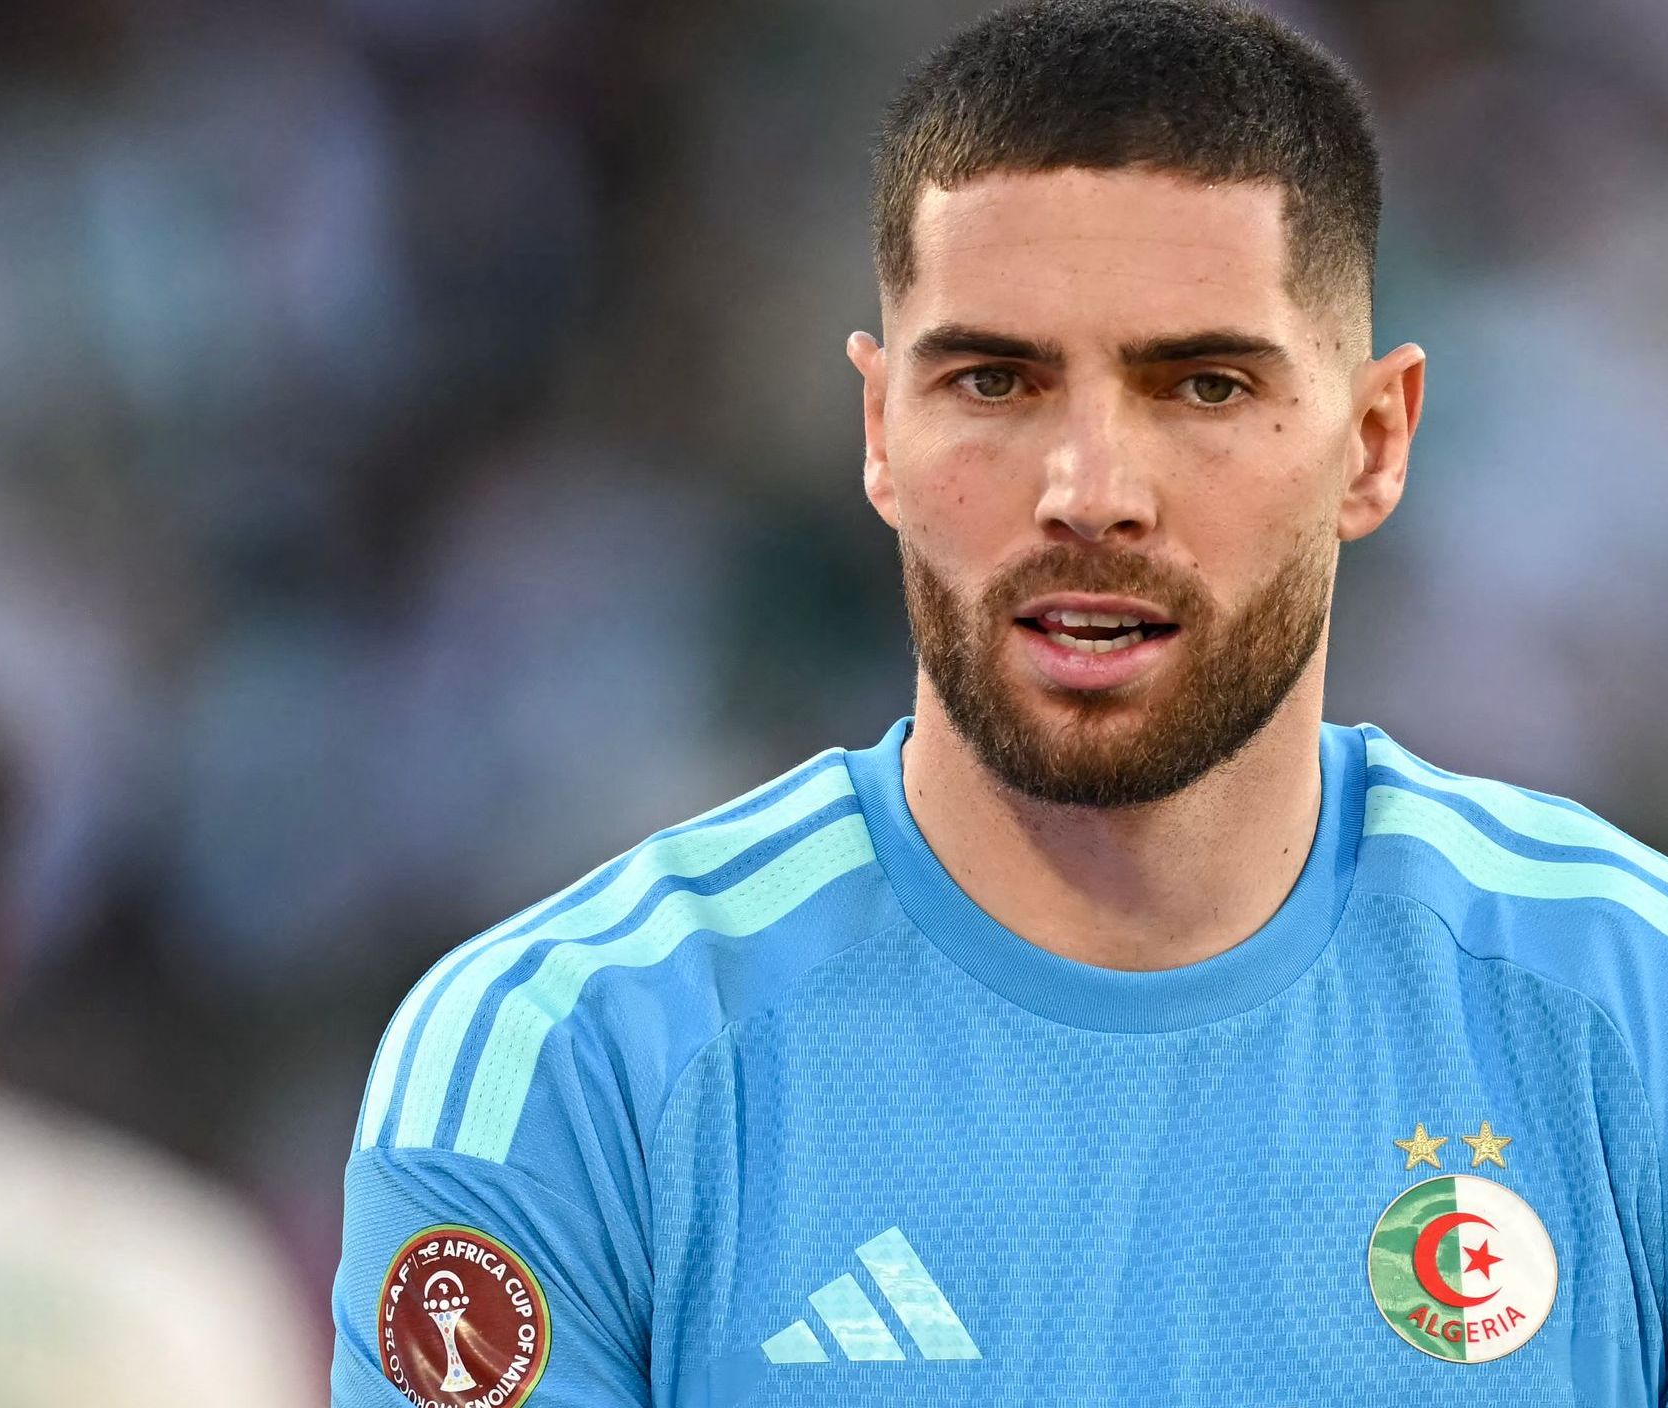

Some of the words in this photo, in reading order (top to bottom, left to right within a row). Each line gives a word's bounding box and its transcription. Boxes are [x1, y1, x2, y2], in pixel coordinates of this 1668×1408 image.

[442, 1239, 507, 1281] AFRICA
[504, 1278, 533, 1318] CUP
[385, 1327, 396, 1351] 25
[518, 1324, 536, 1354] OF
[1407, 1303, 1527, 1343] ALGERIA
